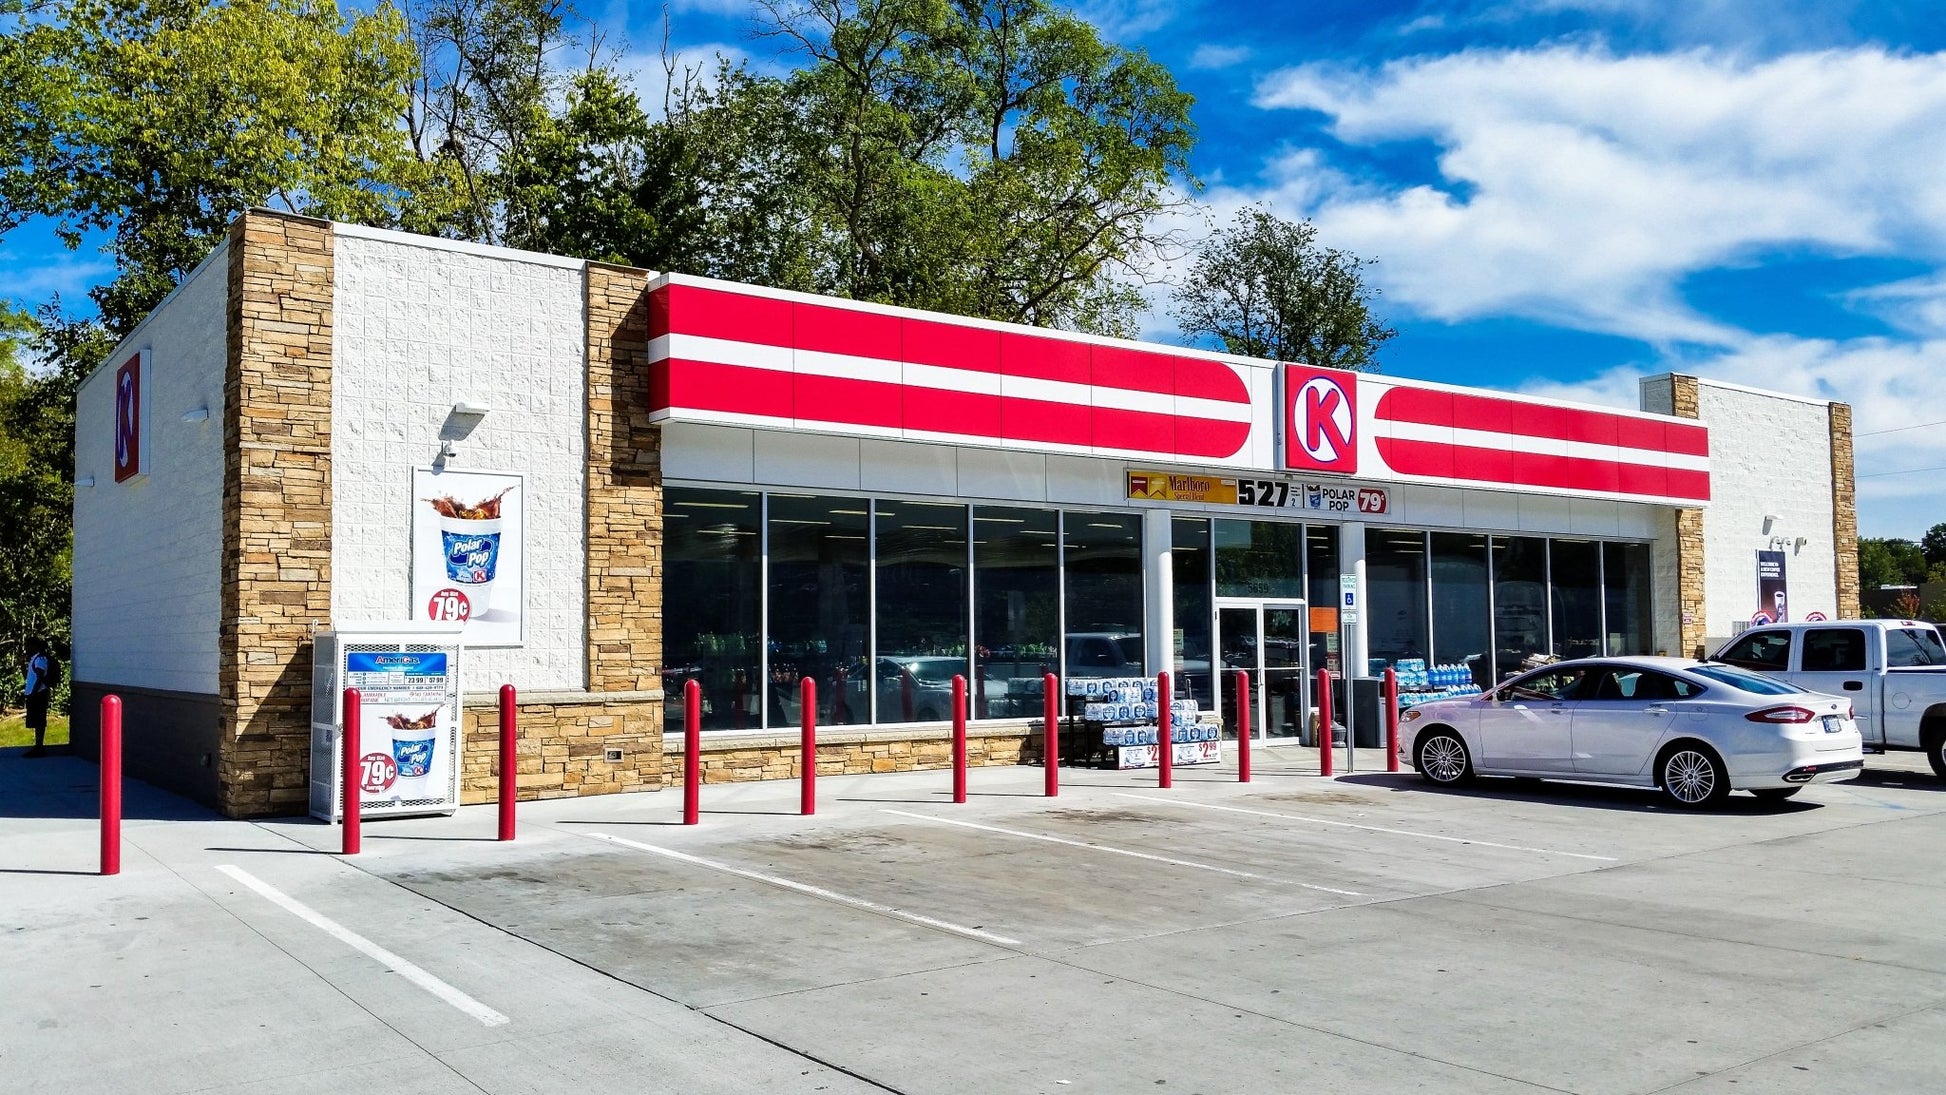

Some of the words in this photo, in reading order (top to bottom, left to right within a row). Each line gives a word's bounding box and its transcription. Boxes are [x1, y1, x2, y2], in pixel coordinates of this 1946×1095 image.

[1304, 384, 1349, 462] K
[1169, 475, 1210, 492] Marlboro
[1238, 479, 1289, 507] 5.27
[1322, 488, 1356, 501] POLAR
[1329, 500, 1350, 512] POP
[453, 537, 483, 555] Polar
[468, 550, 490, 567] Pop
[433, 597, 468, 621] 79¢
[376, 656, 420, 665] AmeriGas
[400, 743, 422, 756] Polar
[410, 753, 427, 764] Pop
[360, 761, 395, 787] 79¢
